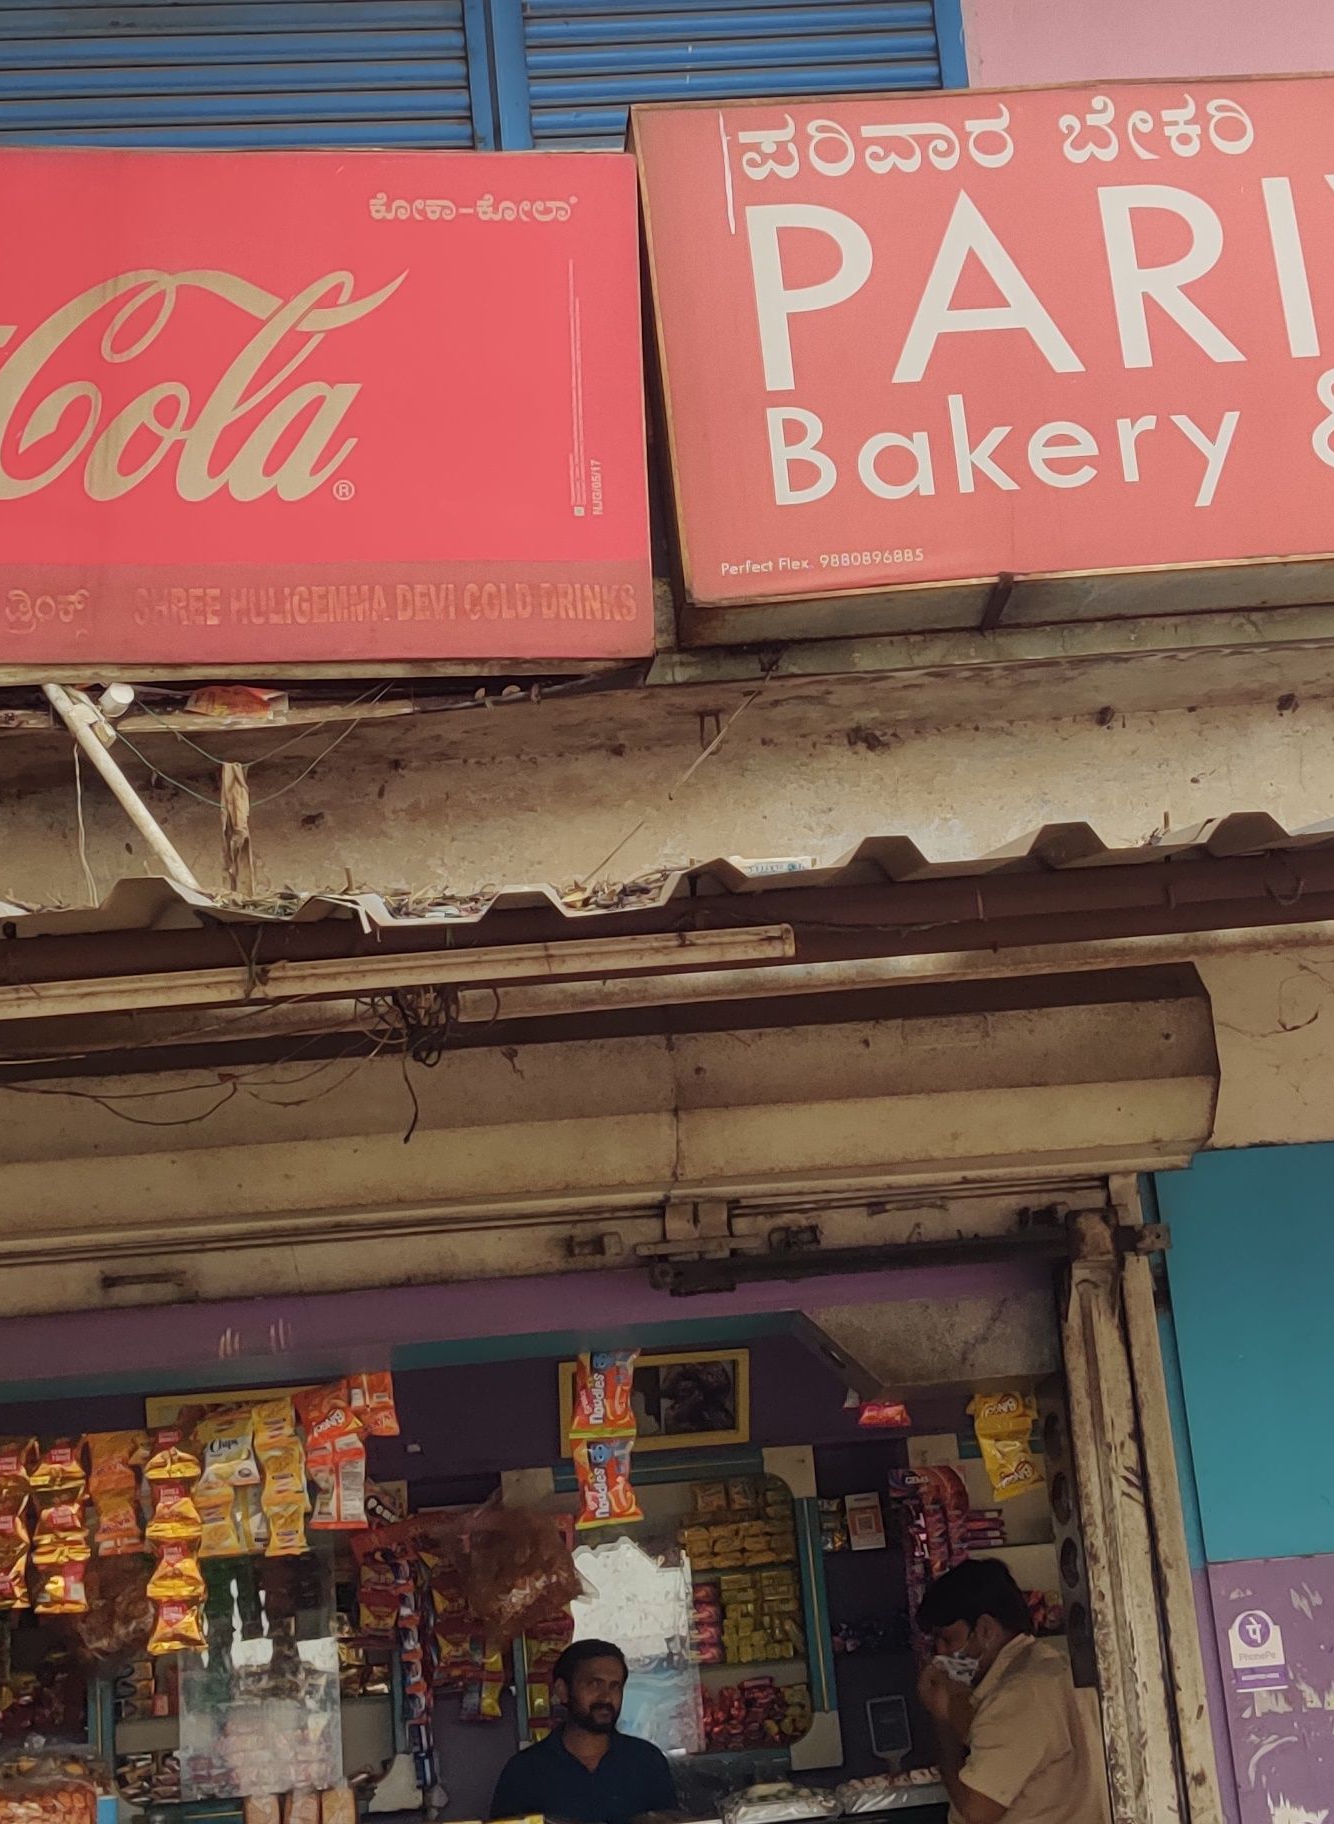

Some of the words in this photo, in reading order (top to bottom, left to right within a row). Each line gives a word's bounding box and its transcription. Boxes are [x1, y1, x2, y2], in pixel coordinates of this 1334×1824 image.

[738, 103, 1014, 181] ಪರಿವಾರ
[1058, 94, 1255, 165] ಬೇಕರಿ
[766, 394, 1241, 507] Bakery
[721, 559, 773, 576] Perfect
[819, 548, 924, 568] 9880896885
[396, 583, 457, 621] DEVI
[540, 582, 637, 621] DRINKS
